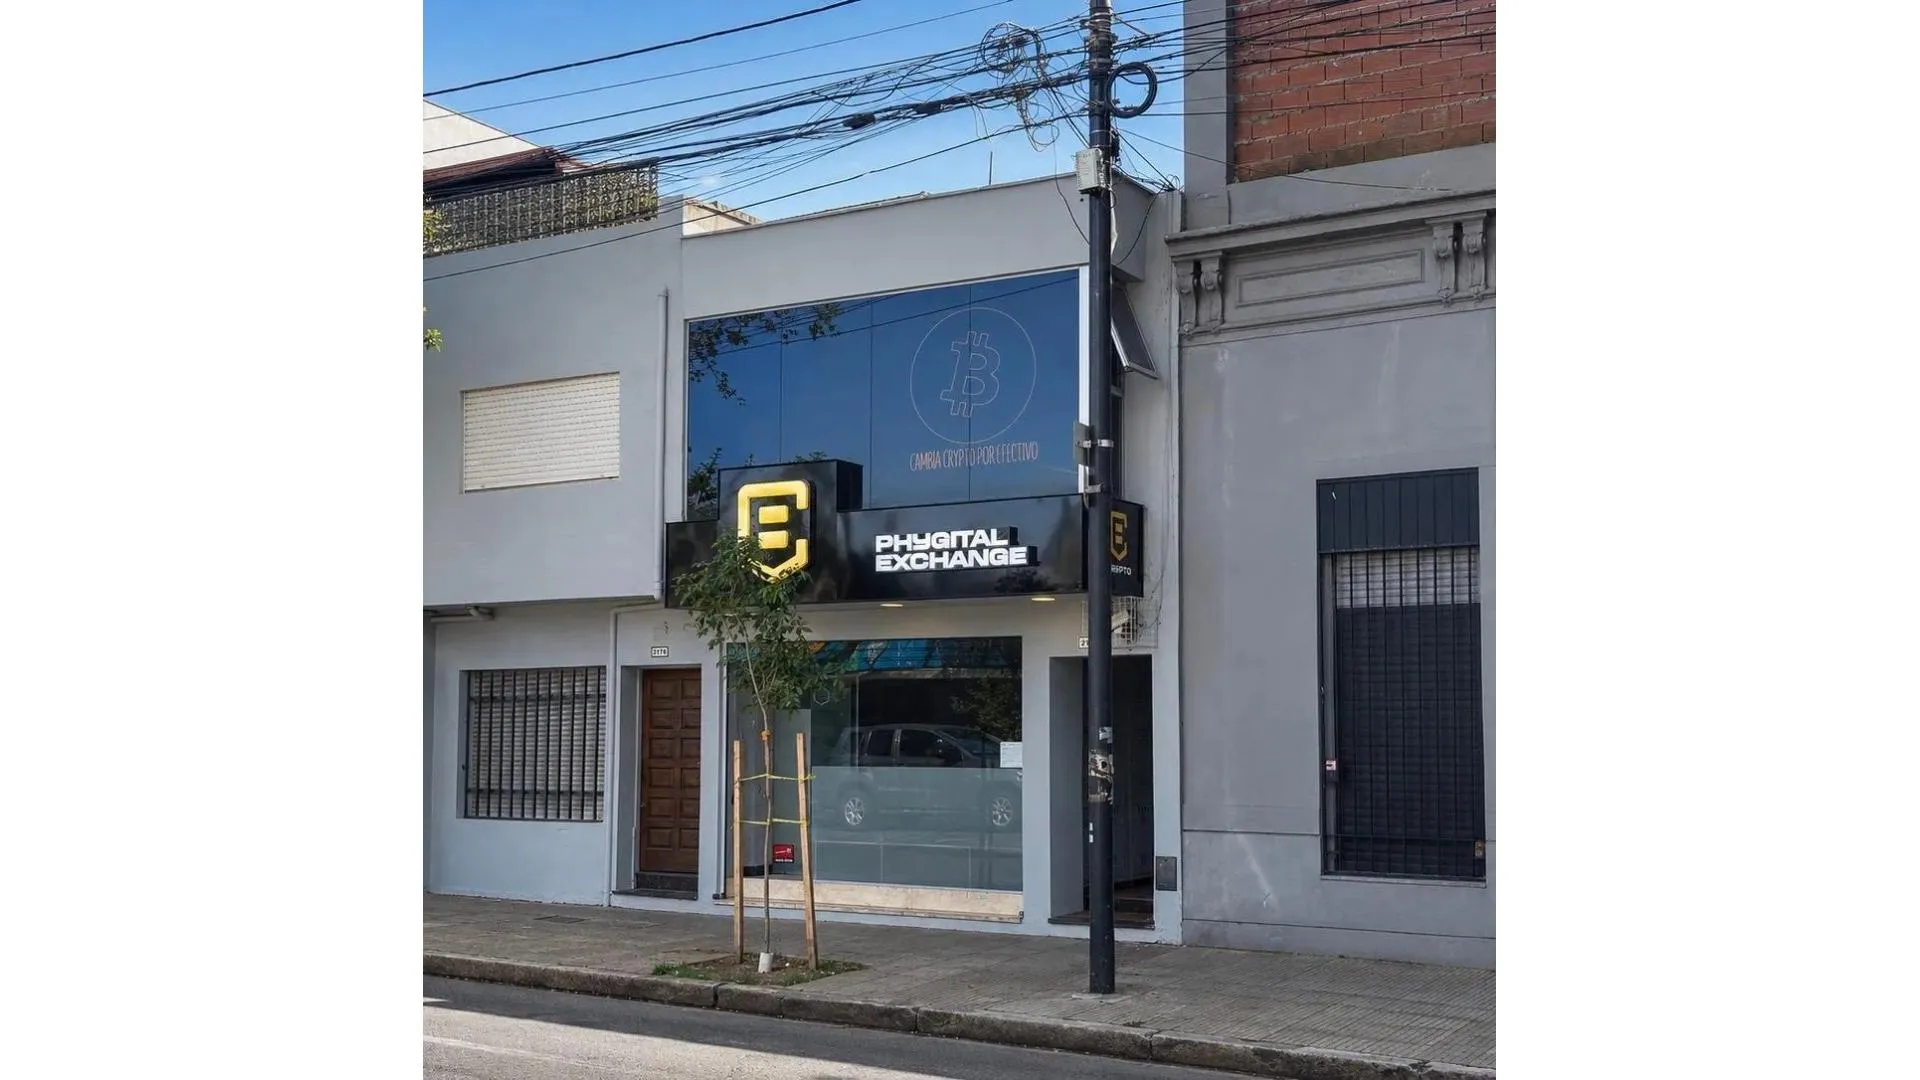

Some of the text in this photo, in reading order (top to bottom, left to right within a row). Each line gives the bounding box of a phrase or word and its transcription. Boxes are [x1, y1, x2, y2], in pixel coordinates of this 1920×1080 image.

[910, 440, 1039, 471] CAMBIA CRYPTO POR EFECTIVO
[875, 528, 1008, 553] PHYGITAL
[875, 546, 1028, 572] EXCHANGE
[1111, 564, 1132, 576] RYPTO
